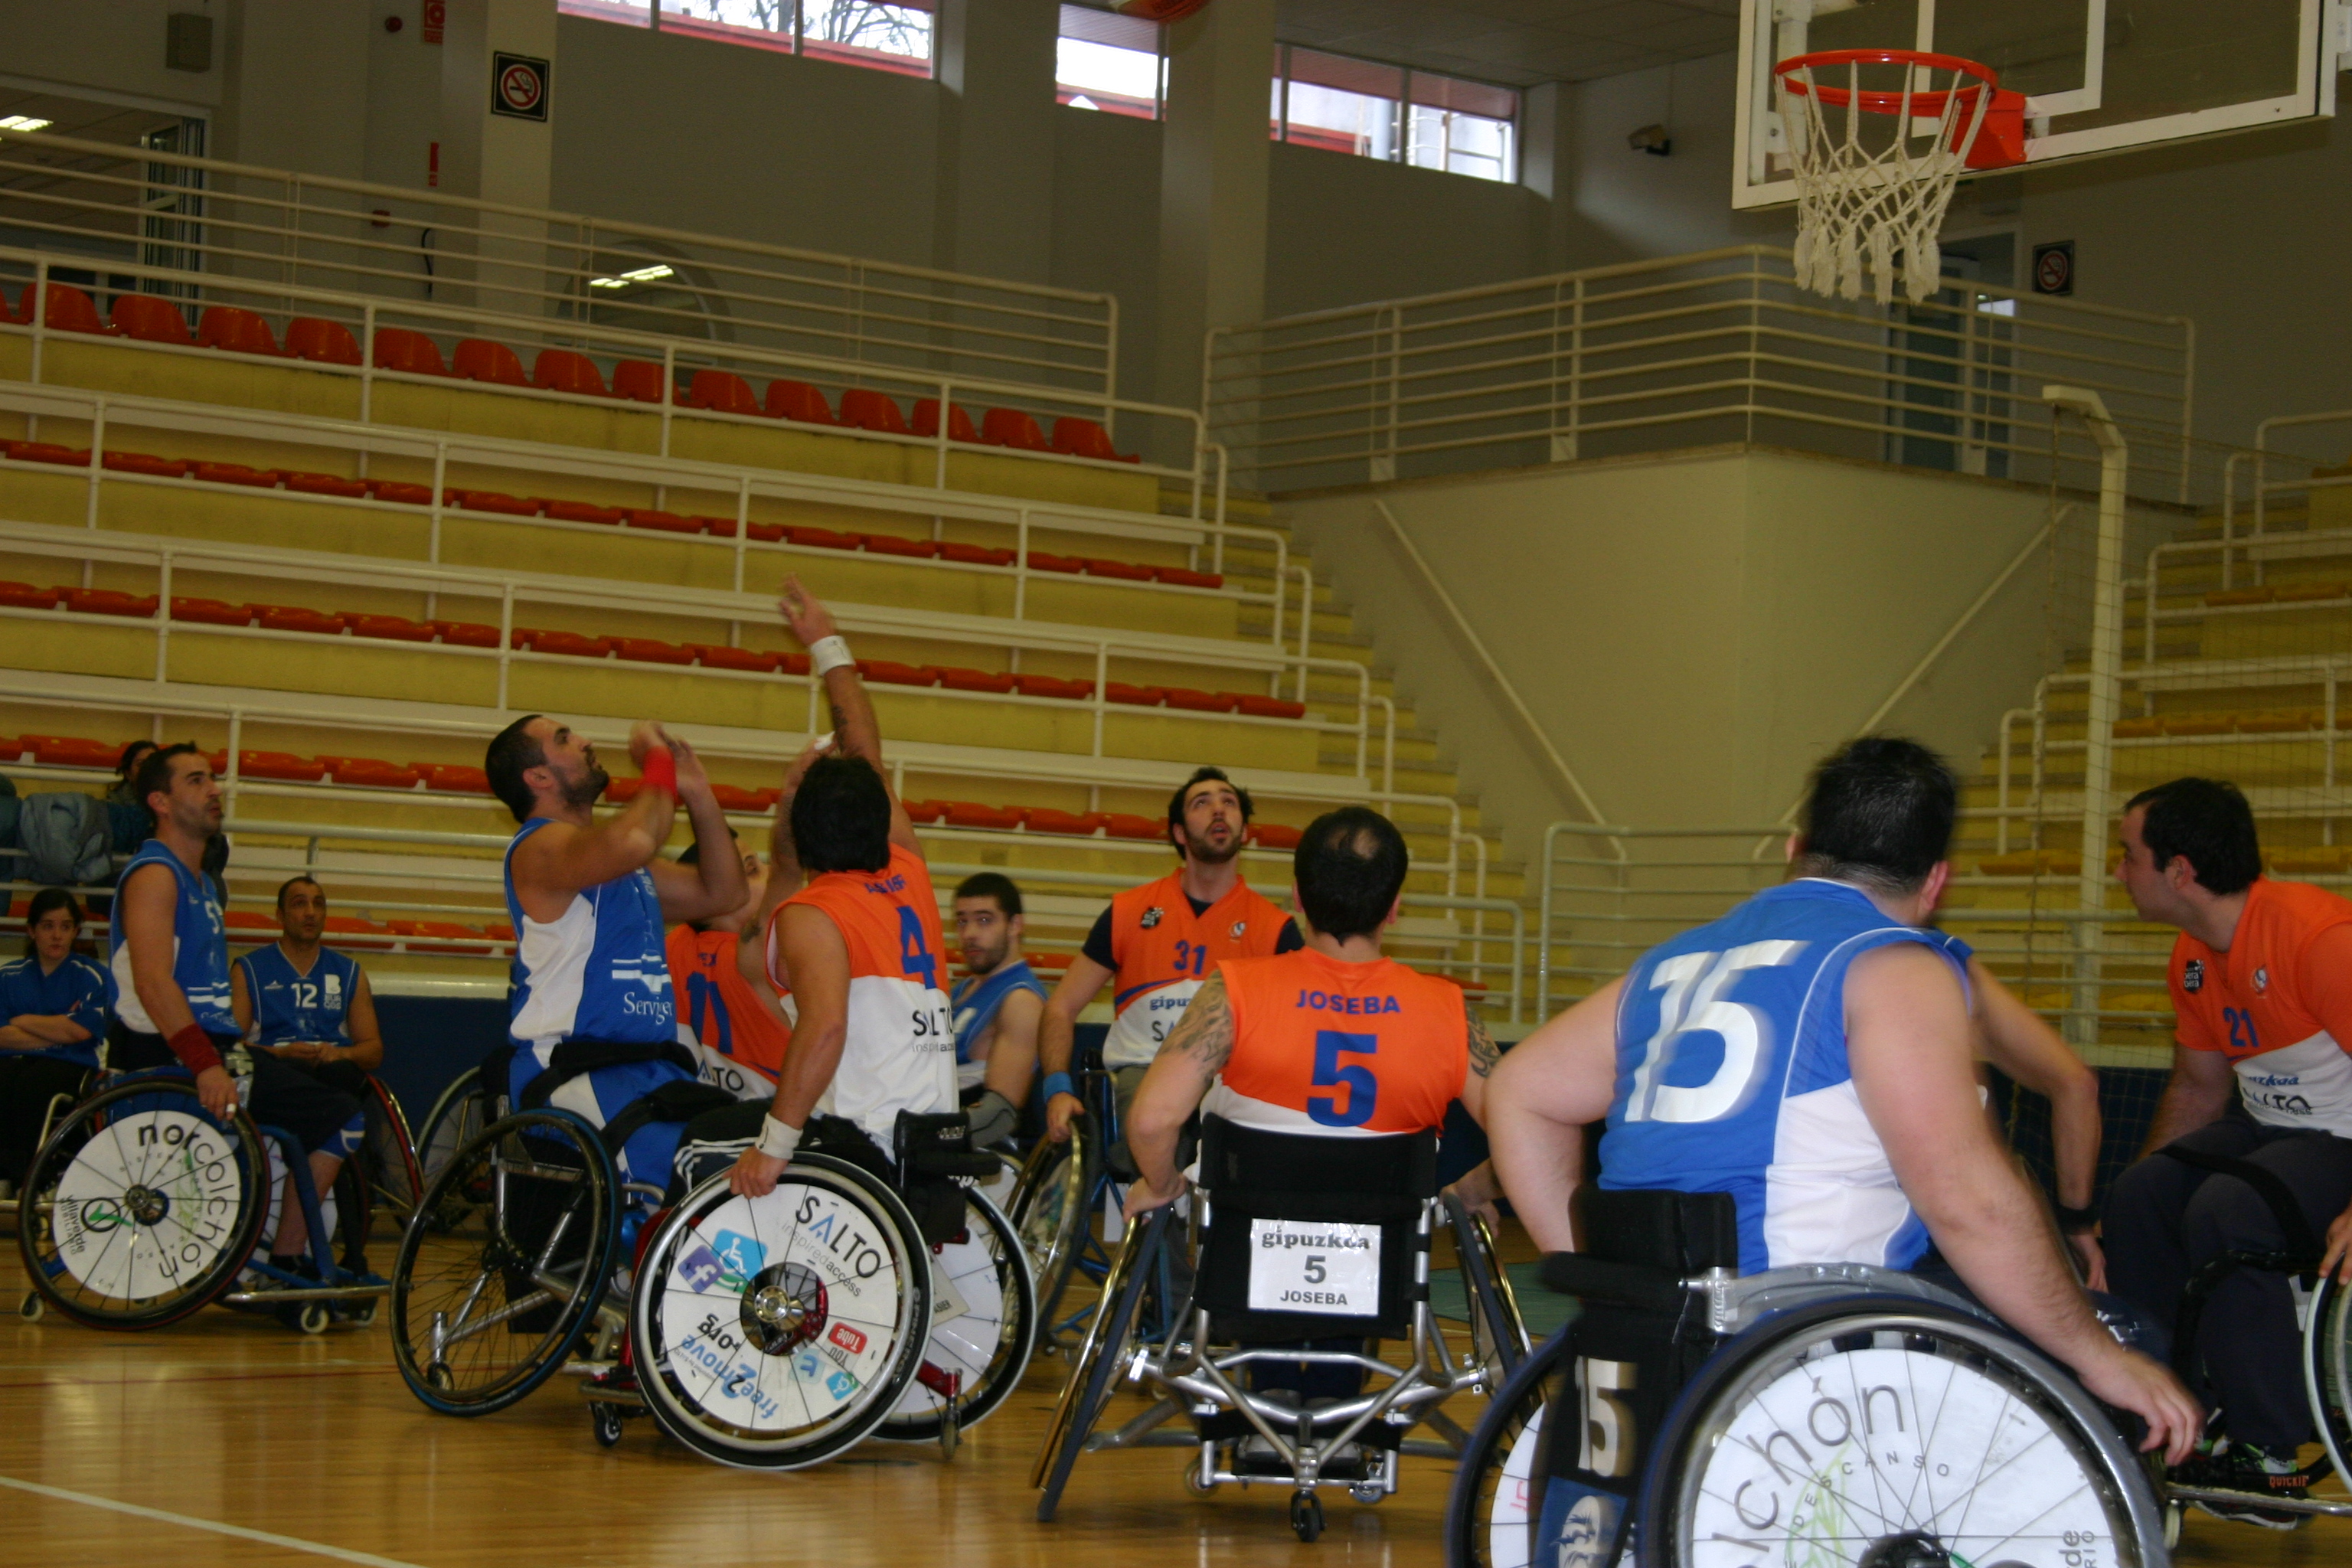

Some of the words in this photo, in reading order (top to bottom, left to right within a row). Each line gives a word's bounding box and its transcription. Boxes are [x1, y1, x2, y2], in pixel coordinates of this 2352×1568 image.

[897, 905, 936, 989] 4
[1174, 939, 1207, 975] 31
[291, 983, 318, 1008] 12
[1150, 995, 1191, 1011] gipu
[1296, 990, 1401, 1014] JOSEBA
[1625, 939, 1808, 1122] 15
[2223, 1008, 2259, 1047] 21
[1306, 1030, 1378, 1128] 5
[139, 1124, 235, 1278] norcolchón
[795, 1195, 880, 1278] SALTO
[1262, 1226, 1370, 1250] gipuzkoa
[1303, 1254, 1327, 1284] 5
[1279, 1290, 1348, 1305] JOSEBA
[837, 1328, 861, 1351] Tube
[681, 1334, 779, 1419] free2move
[1575, 1354, 1637, 1478] 15
[1712, 1376, 1906, 1568] lchón
[1793, 1450, 1950, 1528] DESCANSO
[2269, 1475, 2309, 1488] QUICKIE
